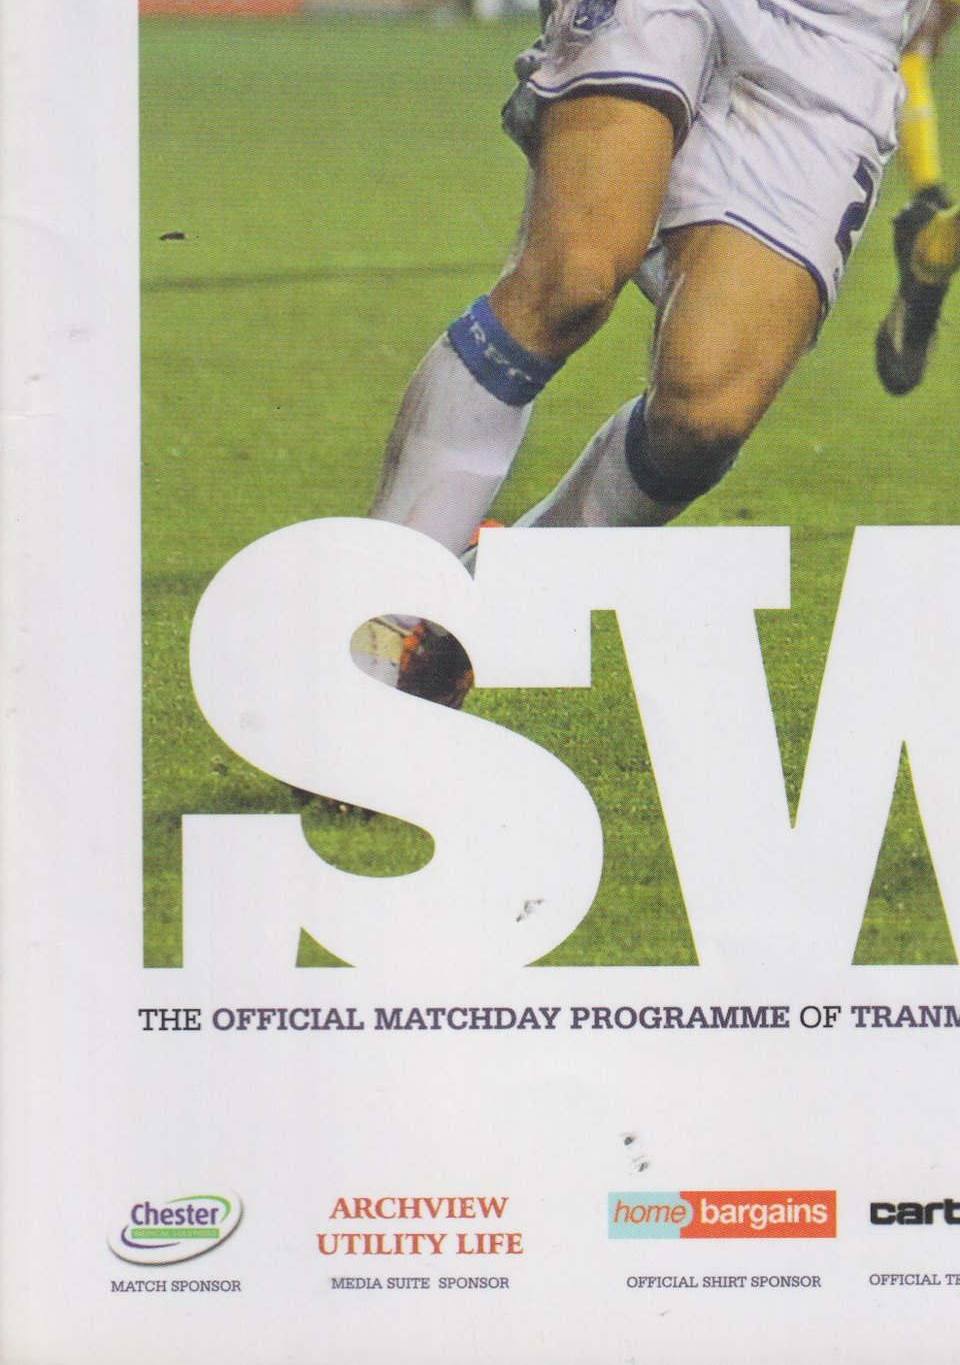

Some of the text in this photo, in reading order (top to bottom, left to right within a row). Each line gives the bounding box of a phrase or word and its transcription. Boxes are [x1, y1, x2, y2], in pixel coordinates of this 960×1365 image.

[138, 1008, 202, 1032] THE
[212, 1008, 365, 1032] OFFICIAL
[374, 1007, 562, 1031] MATCHDAY
[571, 1006, 791, 1030] PROGRAMME
[801, 1006, 842, 1030] OF
[131, 1201, 219, 1226] Chester
[329, 1197, 510, 1220] ARCHVIEW
[614, 1198, 828, 1231] home bargains
[317, 1232, 525, 1256] UTILITY LIFE
[111, 1280, 242, 1294] MATCH SPONSOR
[331, 1277, 510, 1291] MEDIA SUITE SPONSOR
[627, 1276, 822, 1289] OFFICIAL SHIRT SPONSOR
[870, 1274, 942, 1287] OFFICIAL
